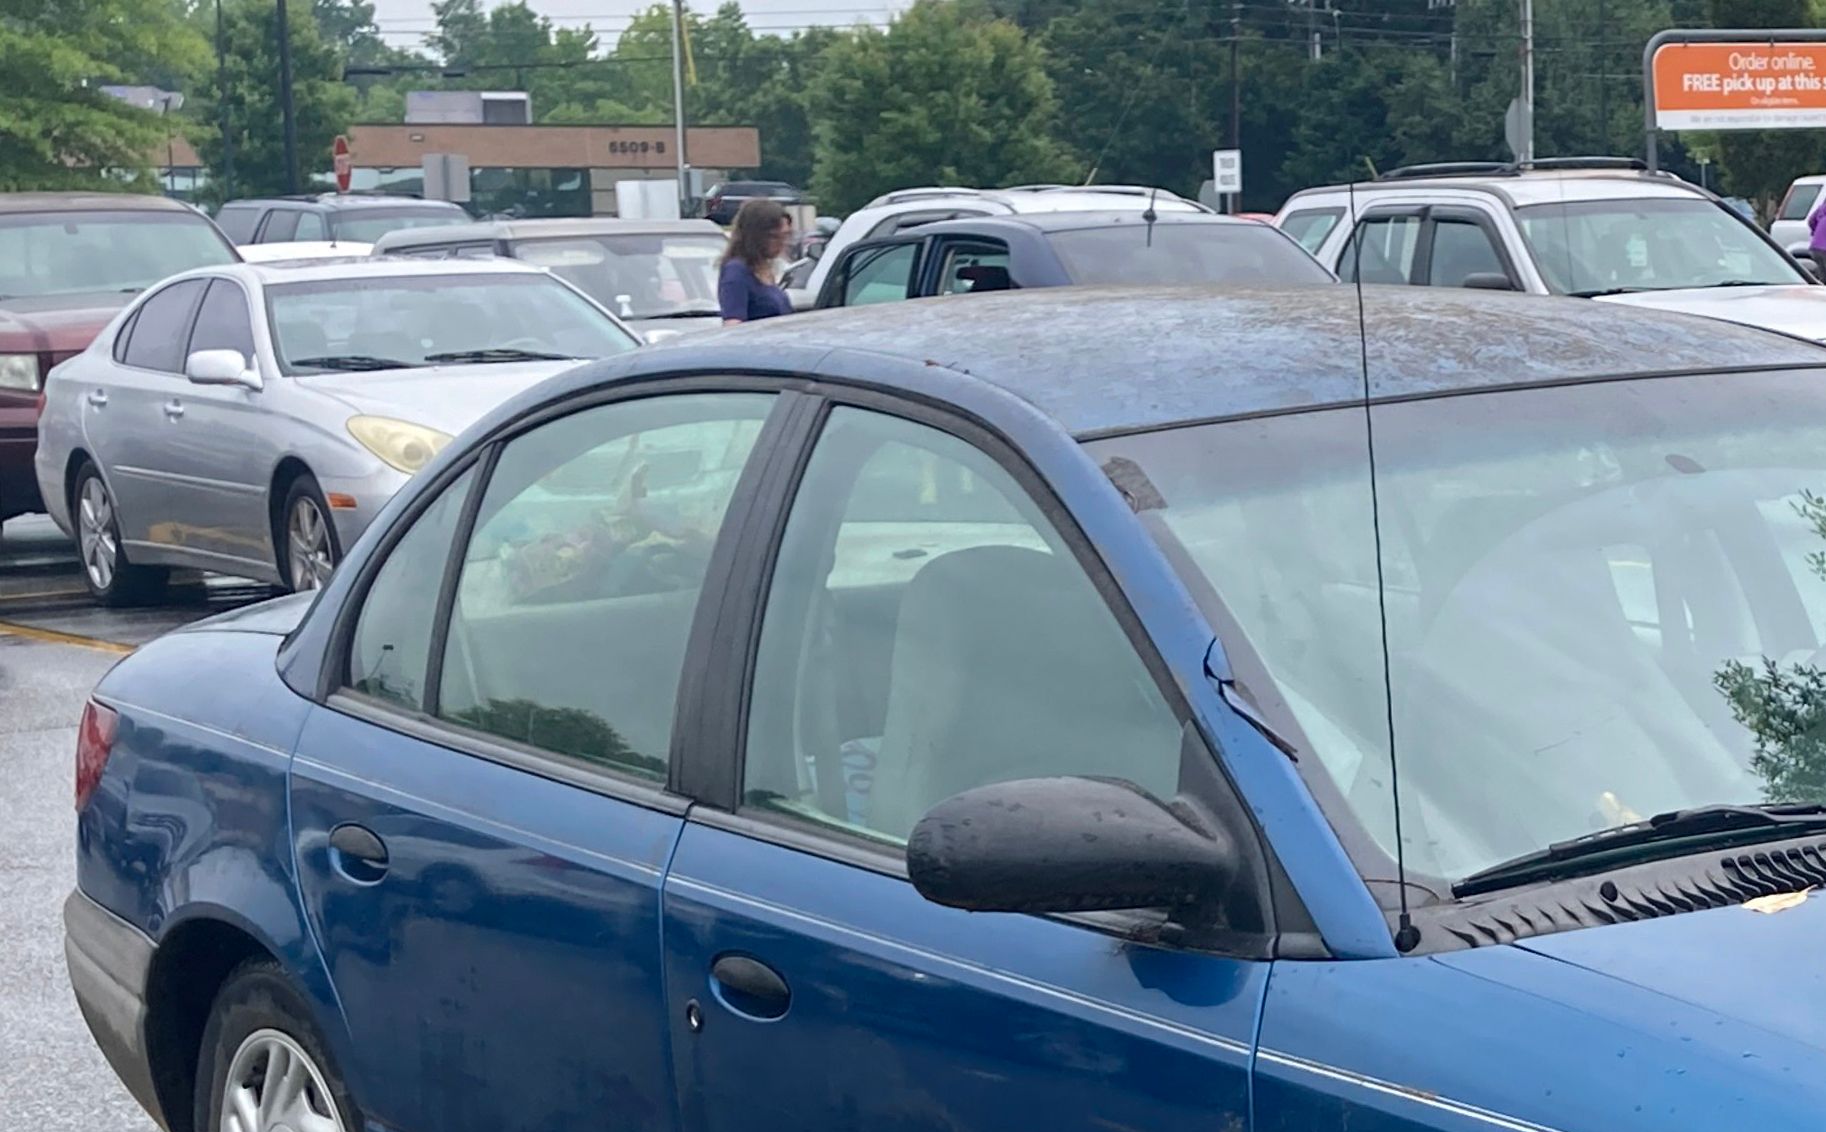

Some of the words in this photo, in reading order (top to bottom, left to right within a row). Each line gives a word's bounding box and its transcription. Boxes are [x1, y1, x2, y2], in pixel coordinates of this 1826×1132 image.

[1728, 51, 1769, 71] Order
[1771, 51, 1817, 70] online.
[1683, 73, 1721, 92] FREE
[1723, 72, 1755, 96] pick
[1755, 77, 1776, 95] up
[1778, 75, 1793, 90] at
[1794, 72, 1821, 90] this
